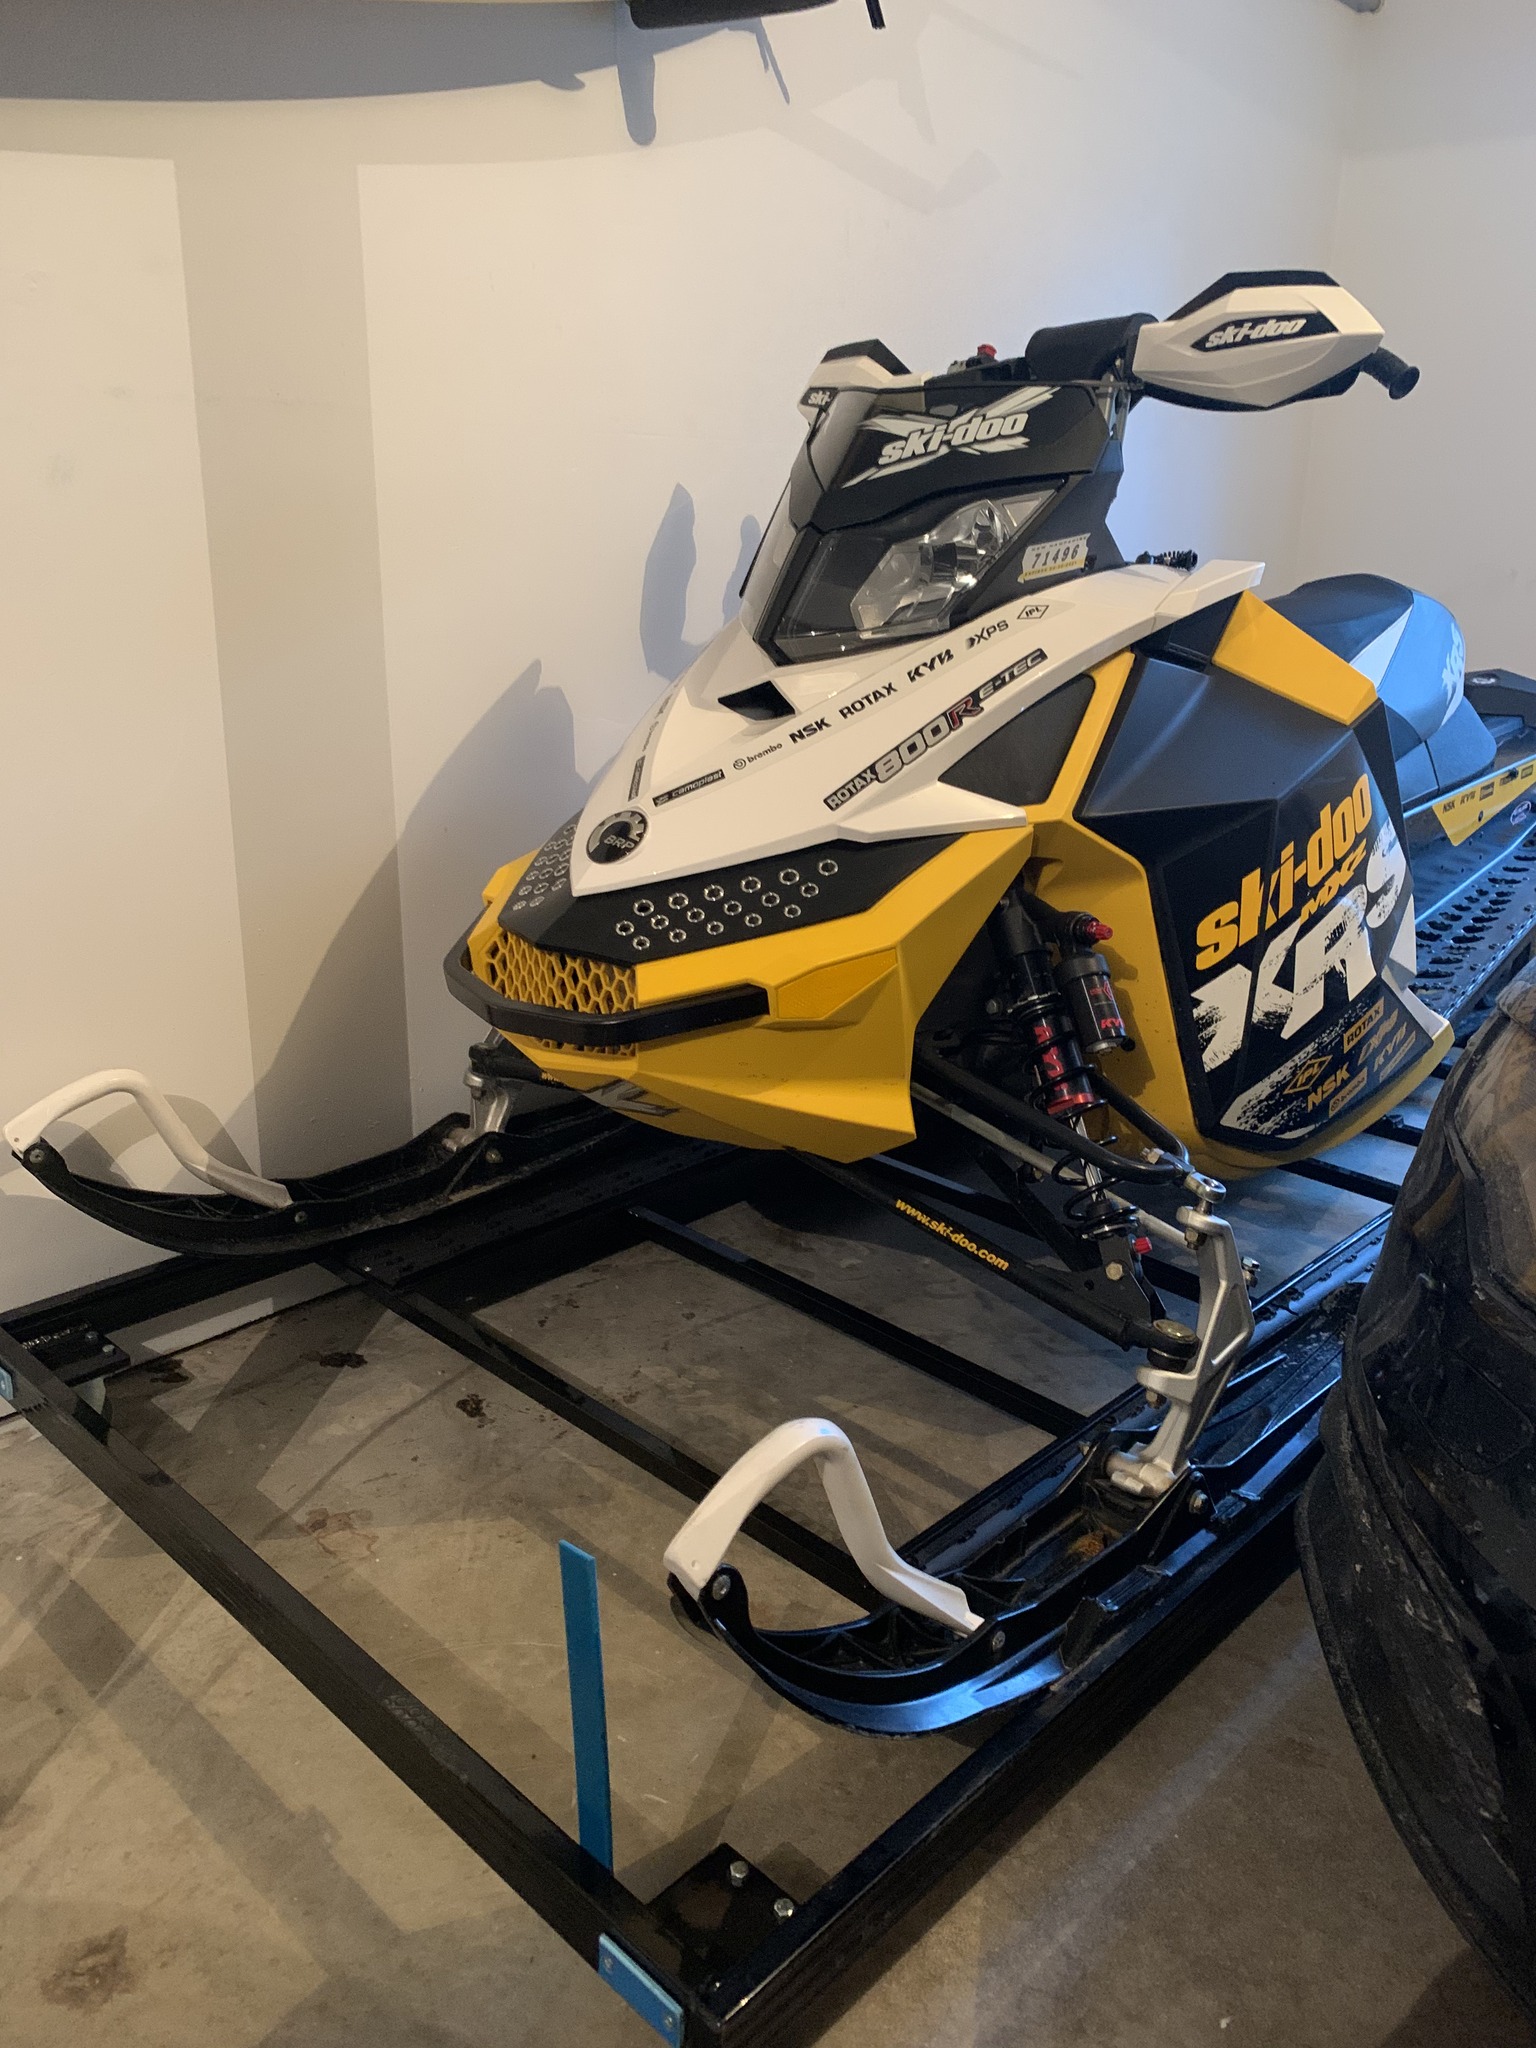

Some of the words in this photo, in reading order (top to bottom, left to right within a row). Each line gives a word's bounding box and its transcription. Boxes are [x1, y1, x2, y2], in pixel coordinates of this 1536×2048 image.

[1205, 318, 1308, 348] ski-doo
[877, 412, 1030, 466] ski-doo
[1031, 543, 1081, 569] 71496
[838, 681, 899, 720] ROTAX
[788, 717, 832, 745] NSK
[826, 767, 877, 811] ROTAX
[979, 649, 1045, 699] E-TEC
[746, 742, 783, 764] brembo
[671, 770, 723, 799] camoplast
[603, 834, 636, 850] BRP
[1195, 772, 1373, 971] ski-doo
[1346, 1005, 1382, 1046] ROTAX
[1307, 1061, 1351, 1114] NSK
[895, 1199, 1010, 1271] www.ski-doo.com
